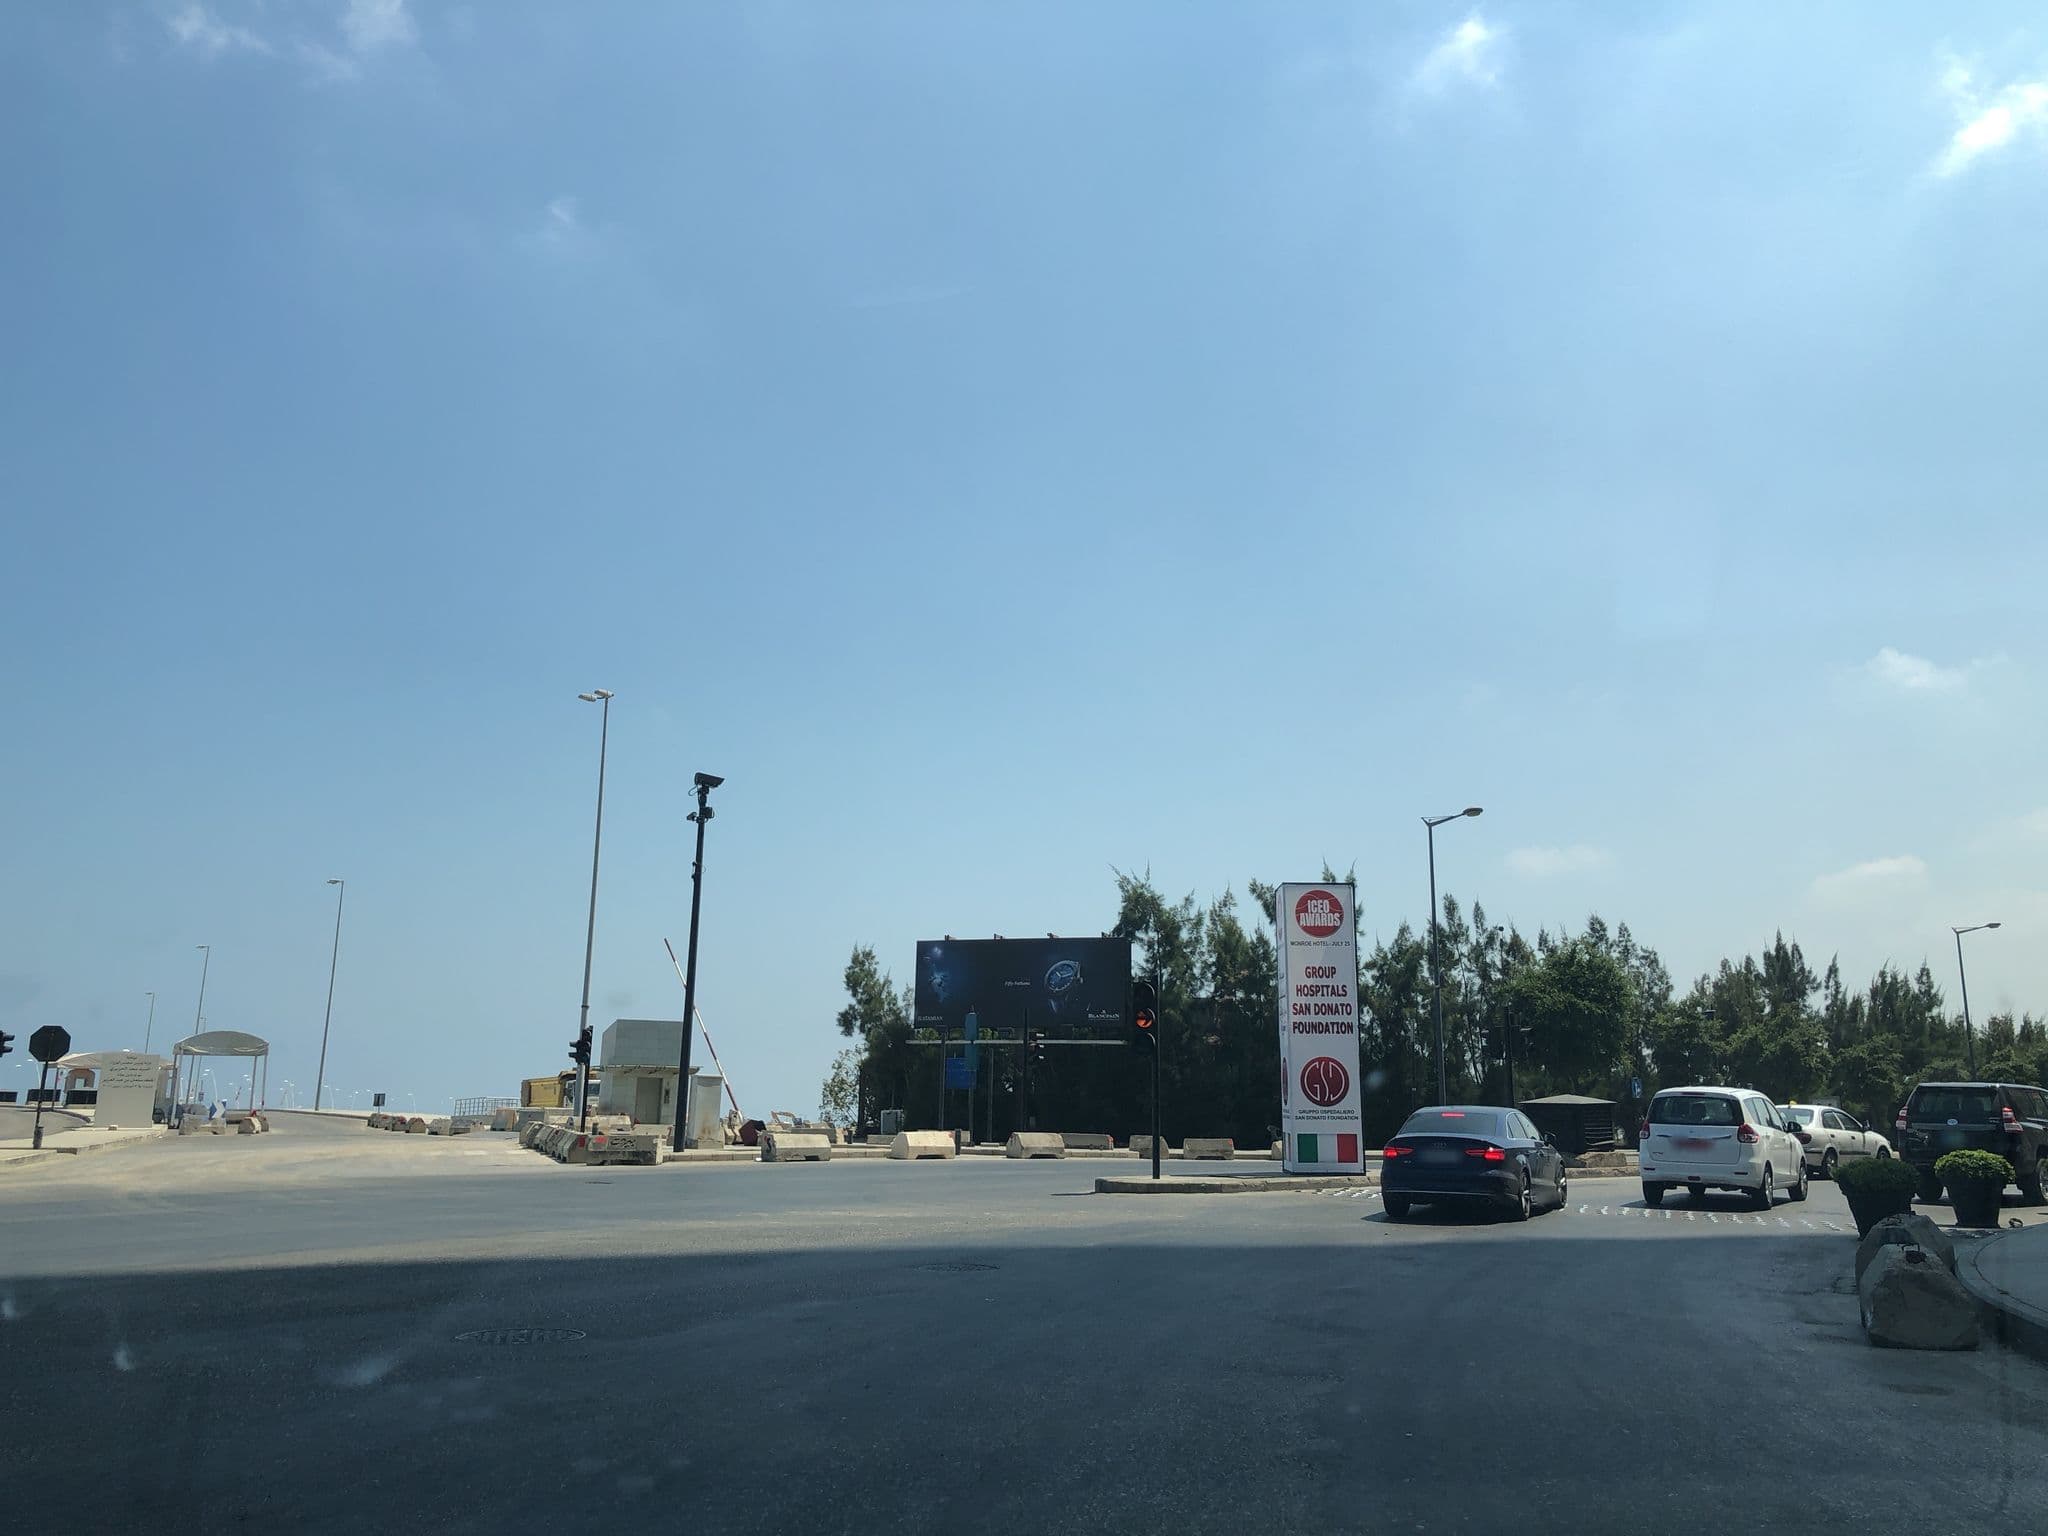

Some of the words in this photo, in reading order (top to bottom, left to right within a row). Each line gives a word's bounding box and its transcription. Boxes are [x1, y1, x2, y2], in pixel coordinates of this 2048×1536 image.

[1299, 912, 1341, 927] AWARDS
[1304, 966, 1337, 979] GROUP
[1296, 984, 1348, 997] HOSPITALS
[1292, 1003, 1311, 1016] SAN
[1314, 1003, 1352, 1016] DONATO
[1292, 1021, 1354, 1035] FOUNDATION
